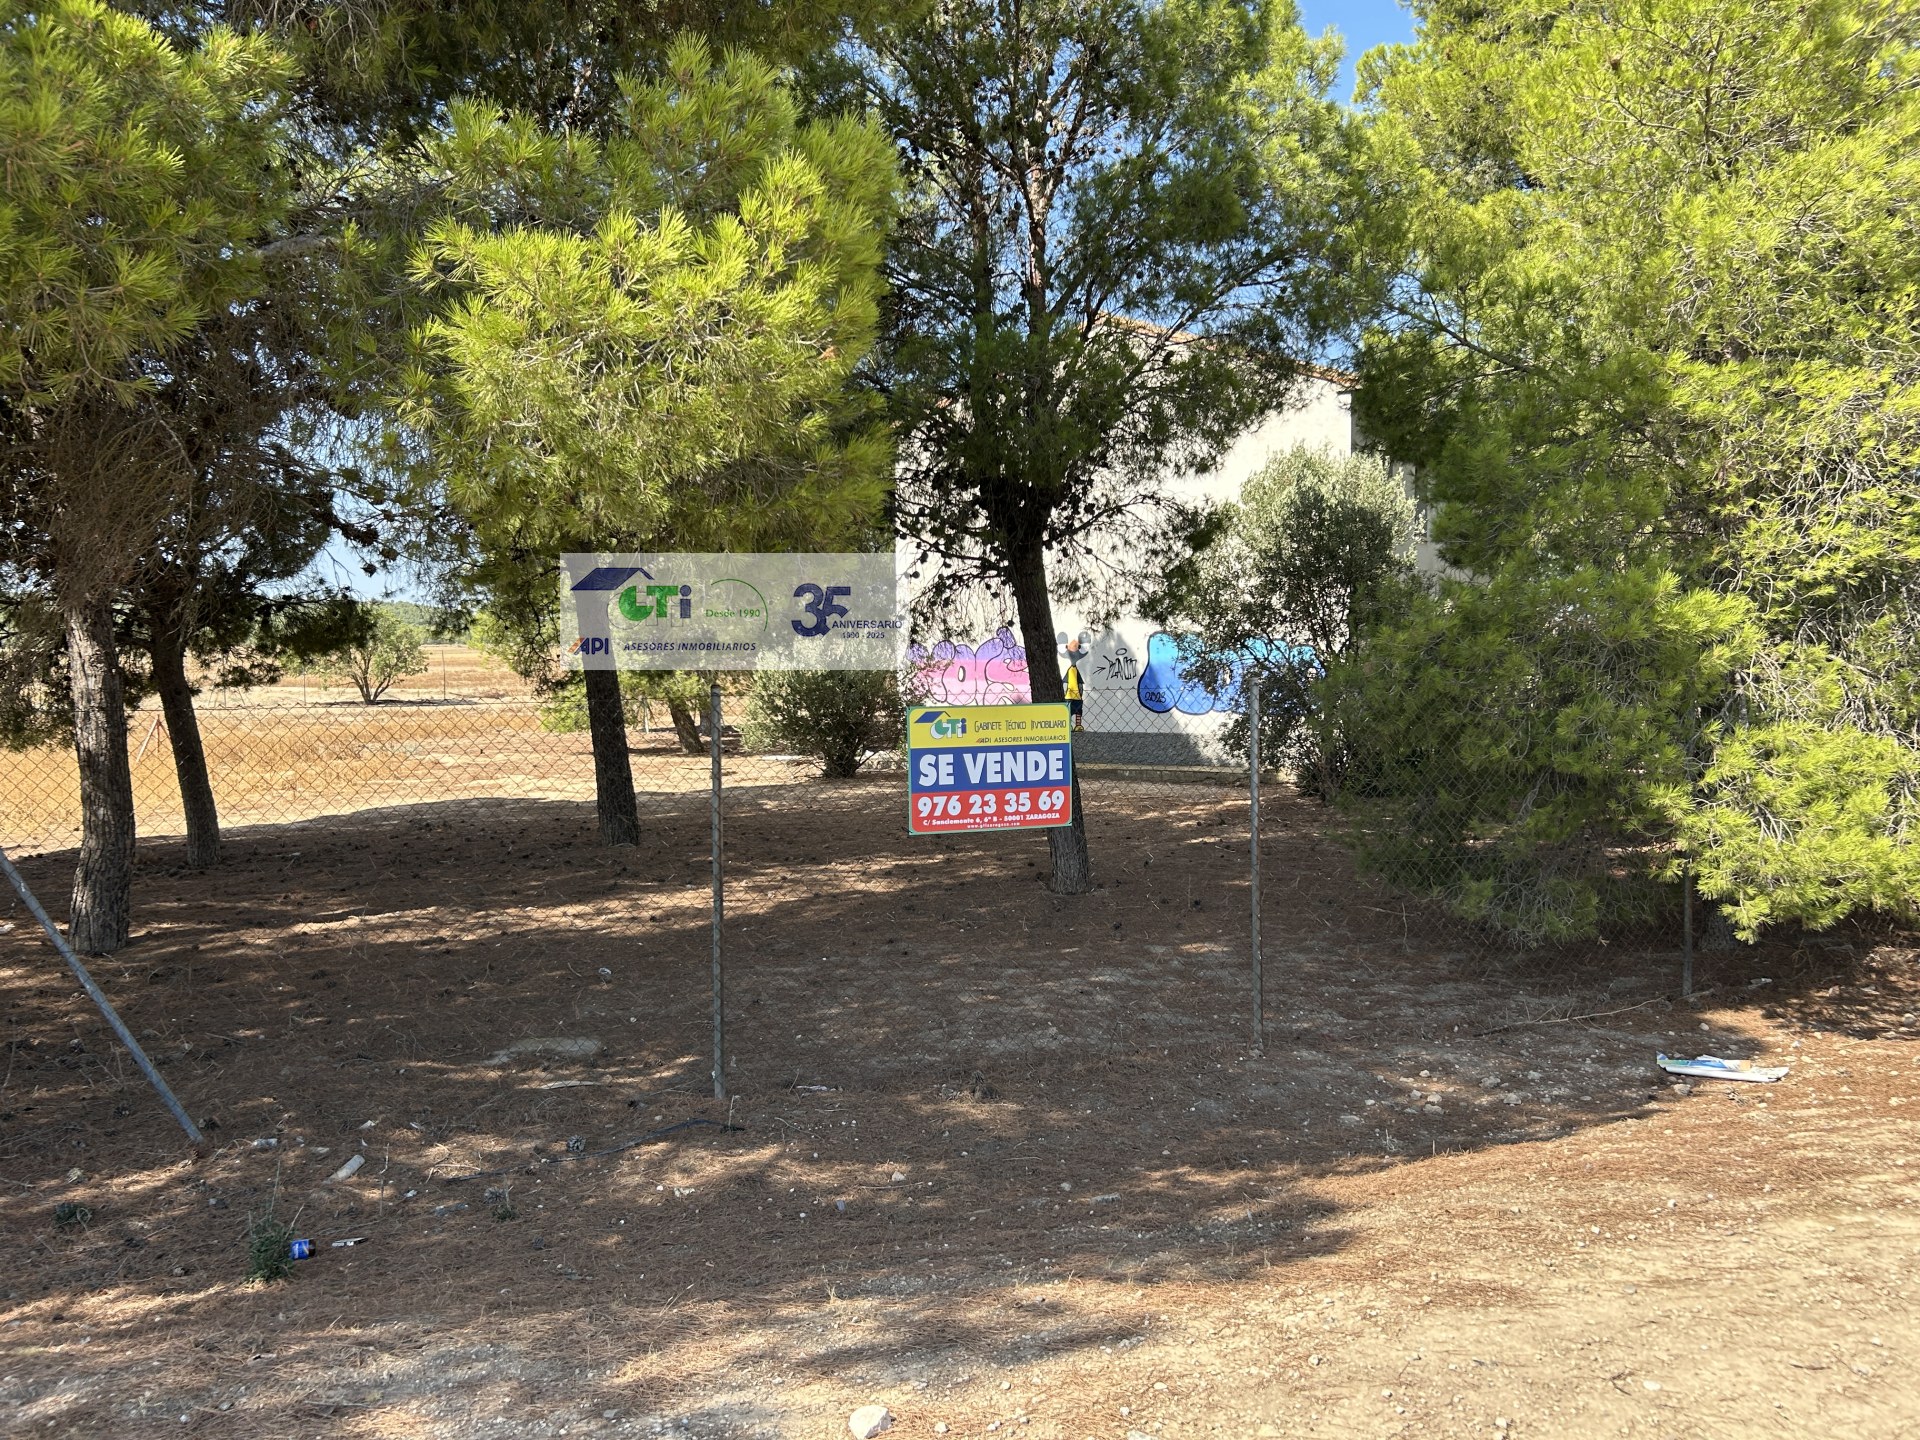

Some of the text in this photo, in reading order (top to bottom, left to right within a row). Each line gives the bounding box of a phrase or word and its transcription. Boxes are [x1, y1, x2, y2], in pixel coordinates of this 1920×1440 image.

[1023, 734, 1067, 742] INMOBILIARIOS
[918, 750, 1064, 786] SE VENDE
[917, 790, 1065, 817] 976 23 35 69
[1025, 812, 1060, 820] ZARAGOZA
